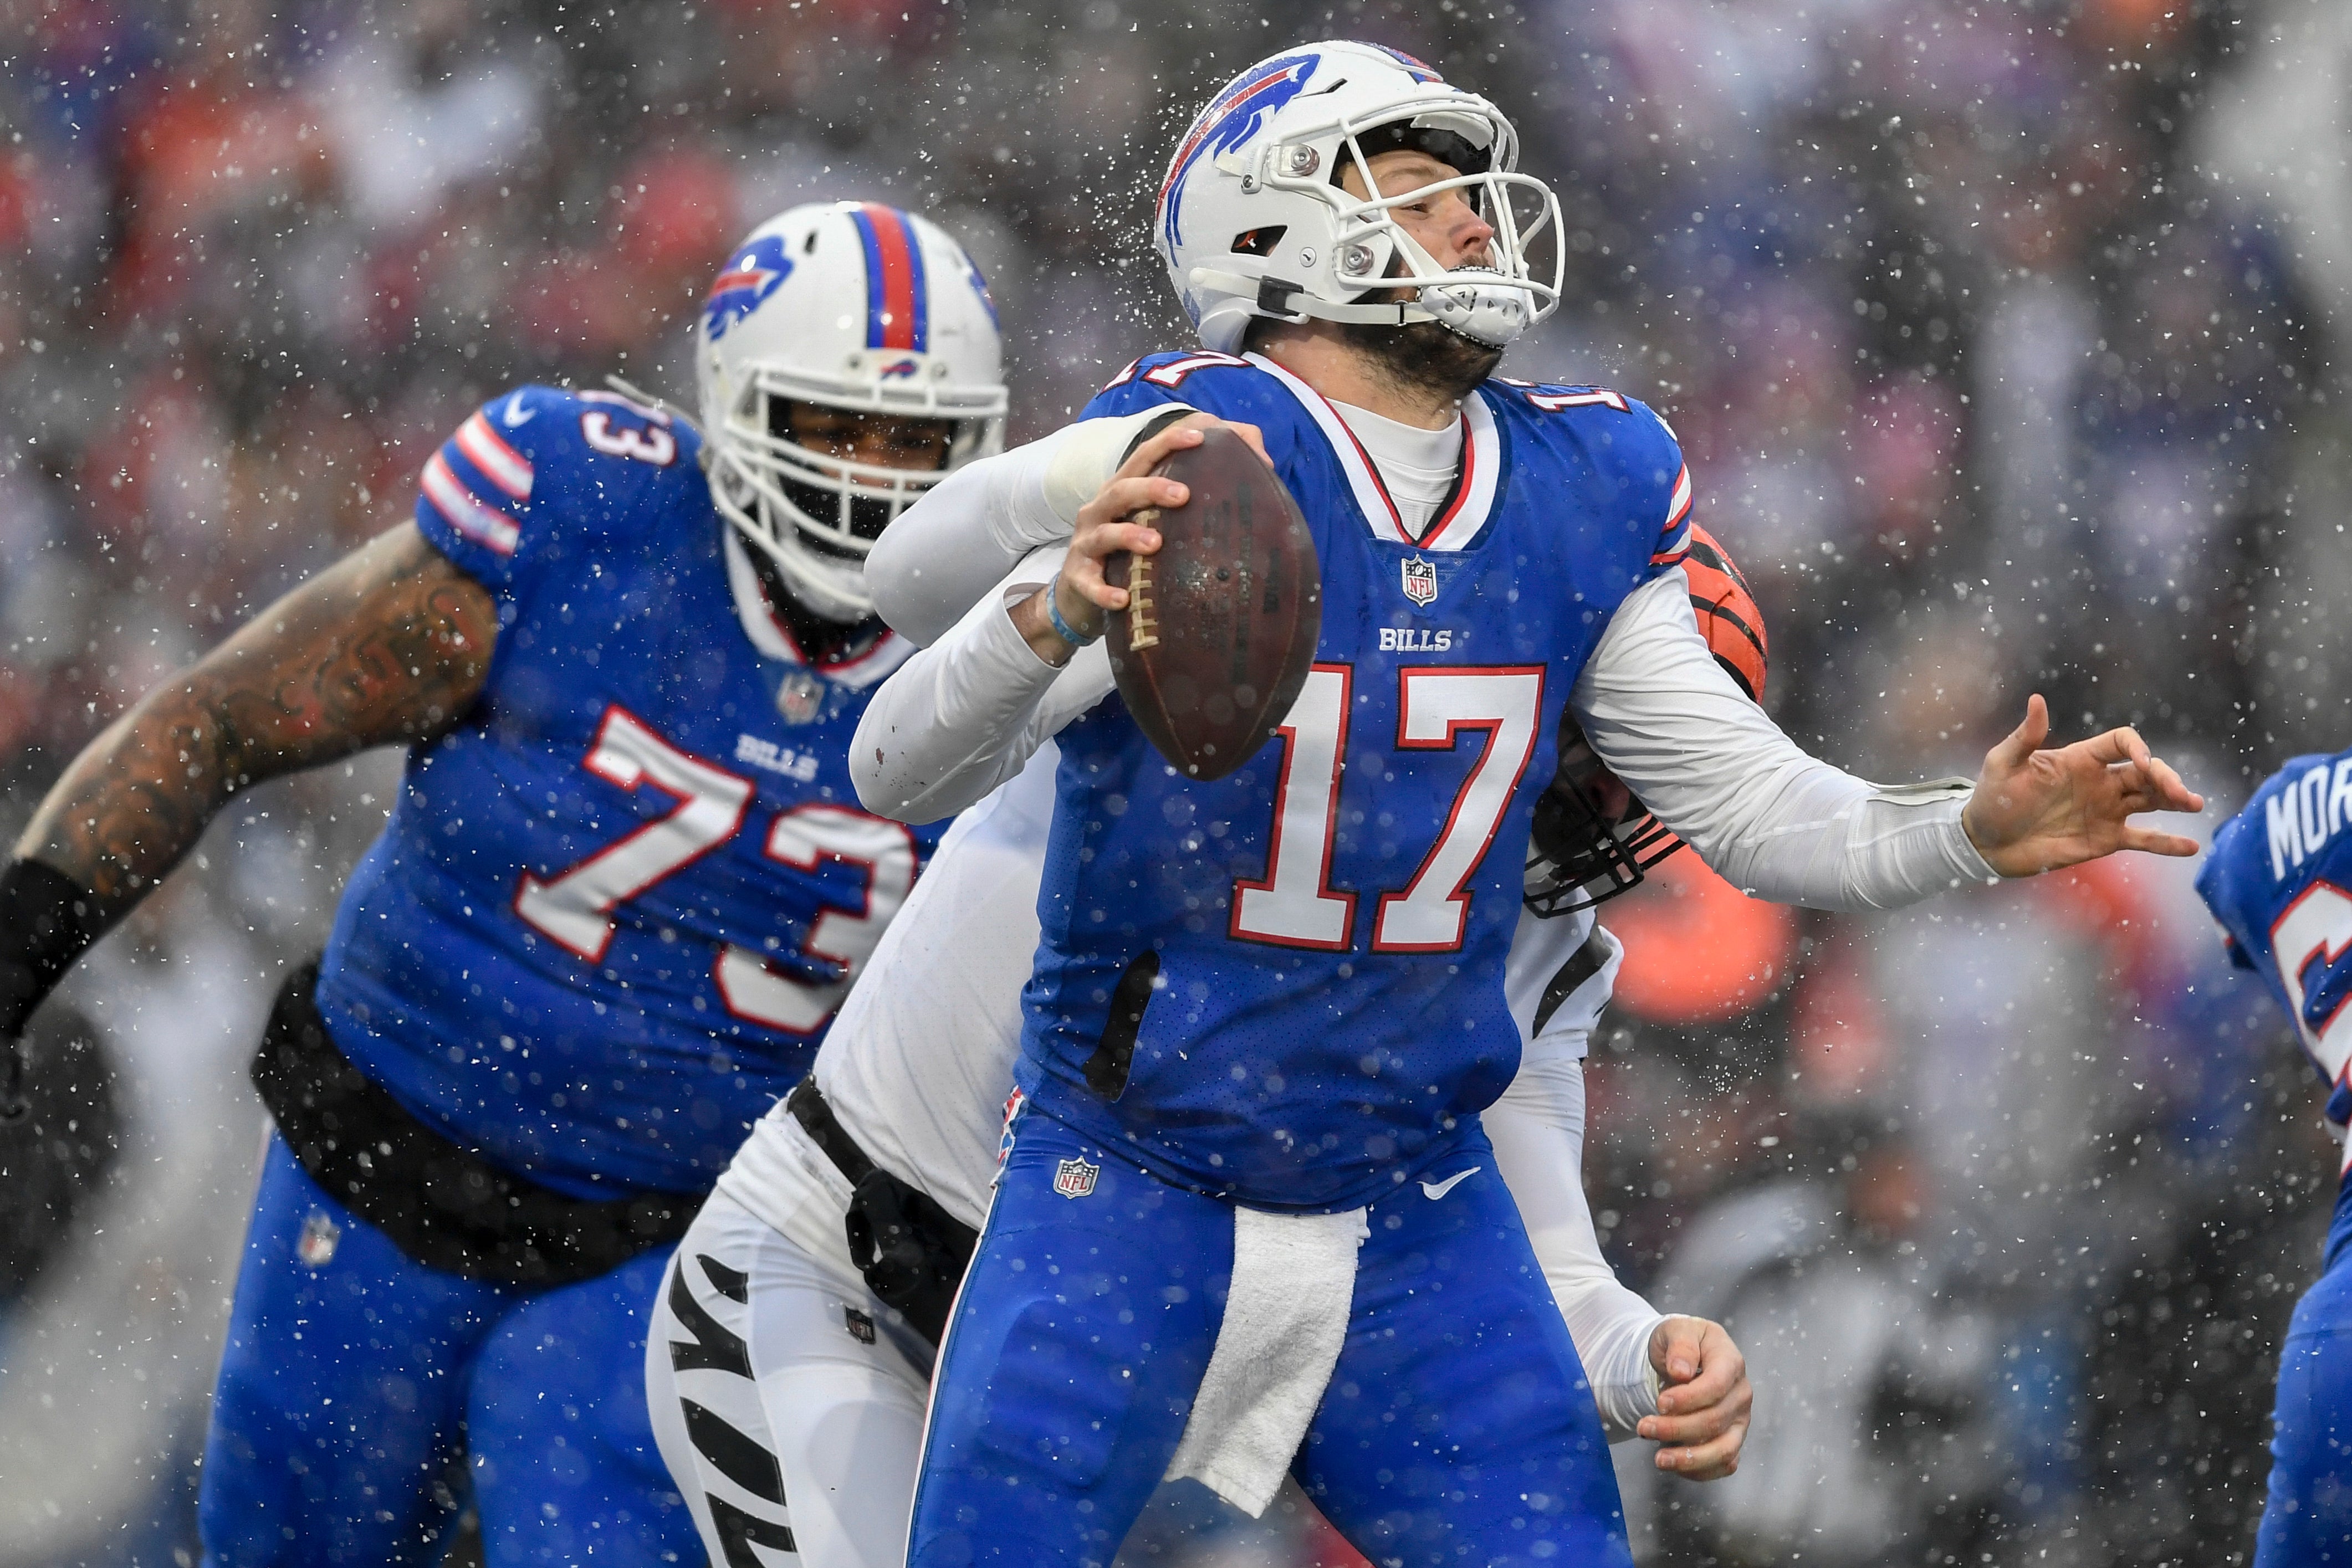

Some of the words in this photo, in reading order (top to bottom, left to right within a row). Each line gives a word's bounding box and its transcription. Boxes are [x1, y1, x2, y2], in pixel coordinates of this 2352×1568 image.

[1409, 576, 1432, 597] NFL
[1378, 627, 1453, 652] BILLS
[1226, 661, 1548, 955] 17
[513, 703, 919, 1036] 73
[1060, 1174, 1088, 1191] NFL
